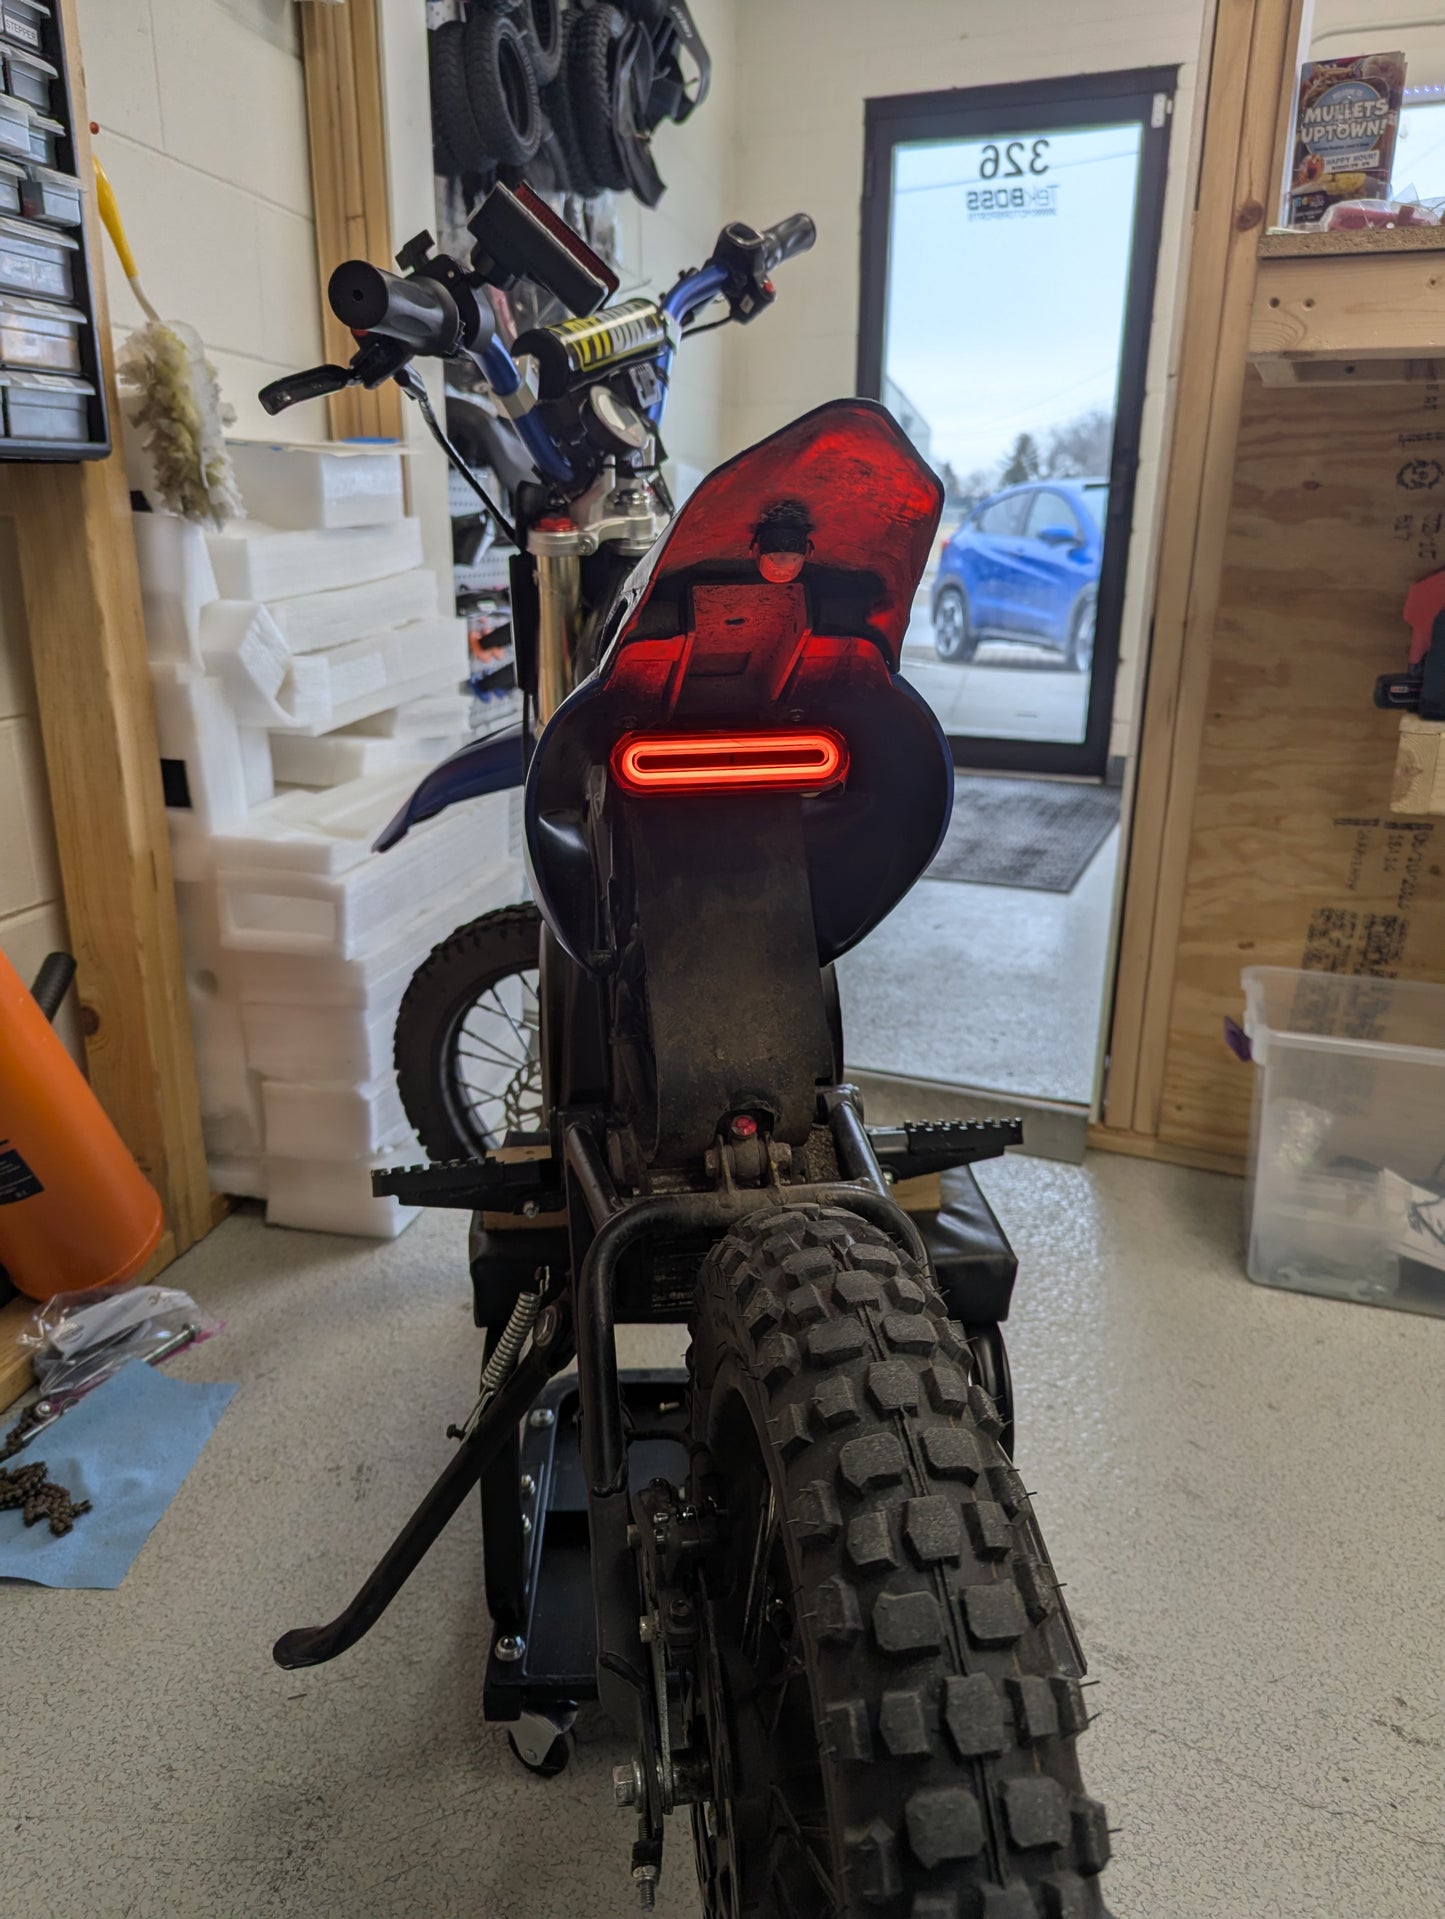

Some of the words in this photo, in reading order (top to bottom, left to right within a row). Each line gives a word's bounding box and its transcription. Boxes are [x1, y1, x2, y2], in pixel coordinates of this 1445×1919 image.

[6, 20, 37, 41] STEPPER
[1304, 98, 1389, 124] MULLETS
[1300, 118, 1388, 144] UPTOWN!
